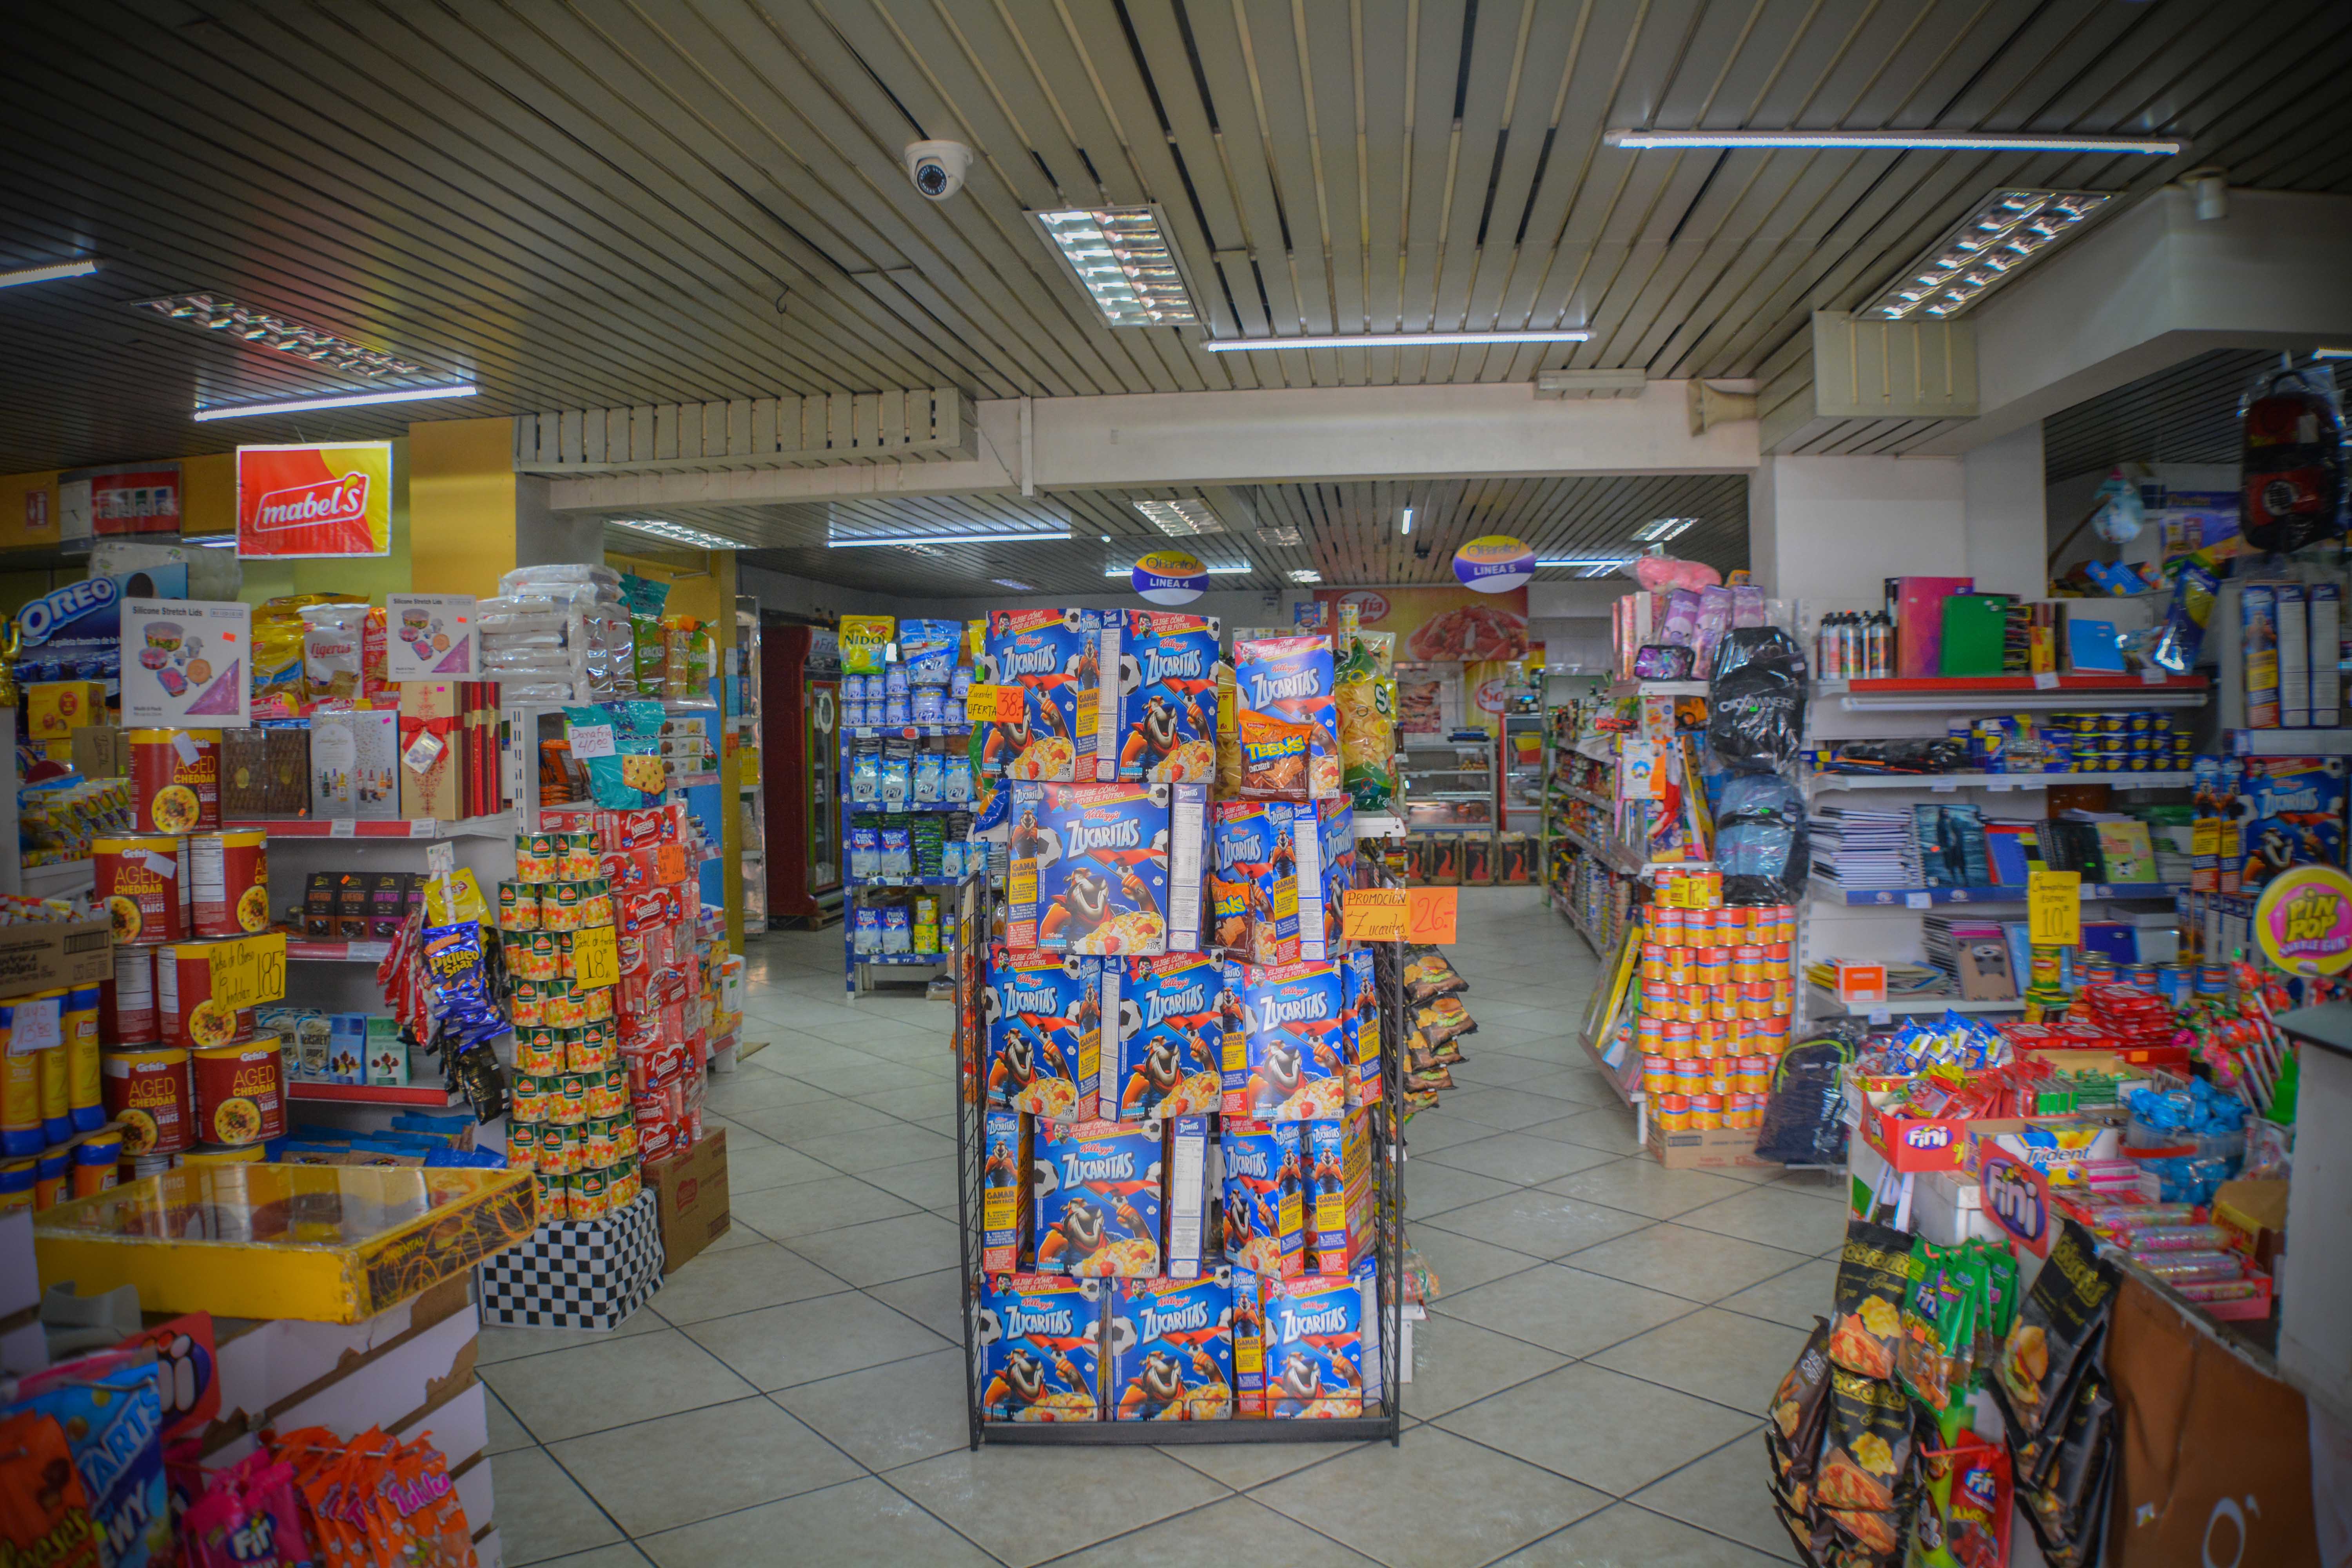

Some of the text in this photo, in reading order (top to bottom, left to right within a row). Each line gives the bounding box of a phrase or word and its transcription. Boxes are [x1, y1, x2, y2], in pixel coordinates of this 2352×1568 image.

[1474, 565, 1506, 575] LINEA
[1150, 578, 1180, 588] LINEA
[22, 580, 112, 637] OREO
[132, 606, 159, 615] Silicone
[162, 607, 186, 615] Stretch
[1011, 615, 1028, 626] ELIGE
[1081, 617, 1100, 633] ZUCARITAS
[1152, 617, 1169, 626] ELIGE
[844, 635, 882, 645] NIDO
[1016, 634, 1043, 647] Kellogg's
[1160, 637, 1187, 652] Kellogg's
[310, 644, 350, 659] Ligeras
[1004, 644, 1056, 683] ZUCARITAS
[1145, 648, 1200, 686] ZUCARITAS
[1271, 663, 1300, 673] Kellogg's
[968, 686, 992, 699] Zucaritas
[1251, 669, 1318, 711] ZUCARITAS
[968, 704, 996, 717] OFERTA
[1245, 737, 1305, 759] TEENS
[174, 756, 215, 774] AGED
[174, 774, 216, 784] CHEDDAR
[858, 784, 871, 793] Pil
[887, 788, 900, 797] Pil
[920, 785, 933, 793] Pil
[950, 788, 964, 797] Pil
[1075, 784, 1118, 798] ELIGE CÓMO
[1102, 791, 1125, 800] FÚTBOL
[1179, 788, 1198, 799] ZUCARITAS
[199, 793, 216, 802] SAUCE
[1084, 809, 1120, 822] Kellogg's
[1270, 806, 1293, 826] ZUCARITAS
[631, 818, 655, 835] Nestlé
[1065, 819, 1139, 859] ZUCARITAS
[1221, 834, 1261, 869] ZUCARITAS
[115, 866, 162, 884] AGED
[114, 884, 163, 894] CHEDDAR
[1348, 892, 1406, 905] PROMOCION
[142, 903, 165, 913] SAUCE
[1347, 911, 1405, 936] Zucaritas
[2287, 916, 2338, 941] POP
[429, 951, 479, 976] Piqueo
[1010, 954, 1026, 962] ELIGE
[1152, 958, 1170, 969] ELIGE
[443, 960, 473, 978] Snax
[1267, 967, 1286, 976] ELIGE
[1016, 973, 1043, 987] Kellogg's
[1160, 976, 1189, 990] Kellogg's
[1281, 986, 1308, 997] Kellogg's
[1003, 982, 1056, 1020] ZUCARITAS
[1146, 984, 1204, 1029] ZUCARITAS
[1260, 991, 1327, 1033] ZUCARITAS
[657, 1057, 678, 1076] Nestlé
[233, 1065, 274, 1088] AGED
[129, 1077, 176, 1098] AGED
[233, 1082, 276, 1097] CHEDDAR
[129, 1095, 176, 1108] CHEDDAR
[260, 1099, 278, 1112] SAUCE
[157, 1113, 179, 1123] SAUCE
[988, 1119, 1015, 1133] ZUCARITAS
[1180, 1121, 1198, 1132] ZUCARITAS
[645, 1132, 669, 1150] Nestlé
[1278, 1126, 1299, 1146] ZUCARITAS
[1314, 1128, 1340, 1143] ZUCARITAS
[1909, 1125, 1948, 1148] Fini
[1080, 1142, 1114, 1156] Kellogg's
[2026, 1147, 2092, 1163] Trident
[1227, 1145, 1267, 1180] ZUCARITAS
[1062, 1152, 1134, 1190] ZUCARITAS
[1989, 1164, 2037, 1238] Fini
[1233, 1274, 1255, 1289] ZUCARITAS
[1021, 1297, 1054, 1310] Kellogg's
[1157, 1295, 1191, 1308] Kellogg's
[1004, 1306, 1072, 1340] ZUCARITAS
[1140, 1301, 1208, 1345] ZUCARITAS
[1280, 1306, 1347, 1345] ZUCARITAS
